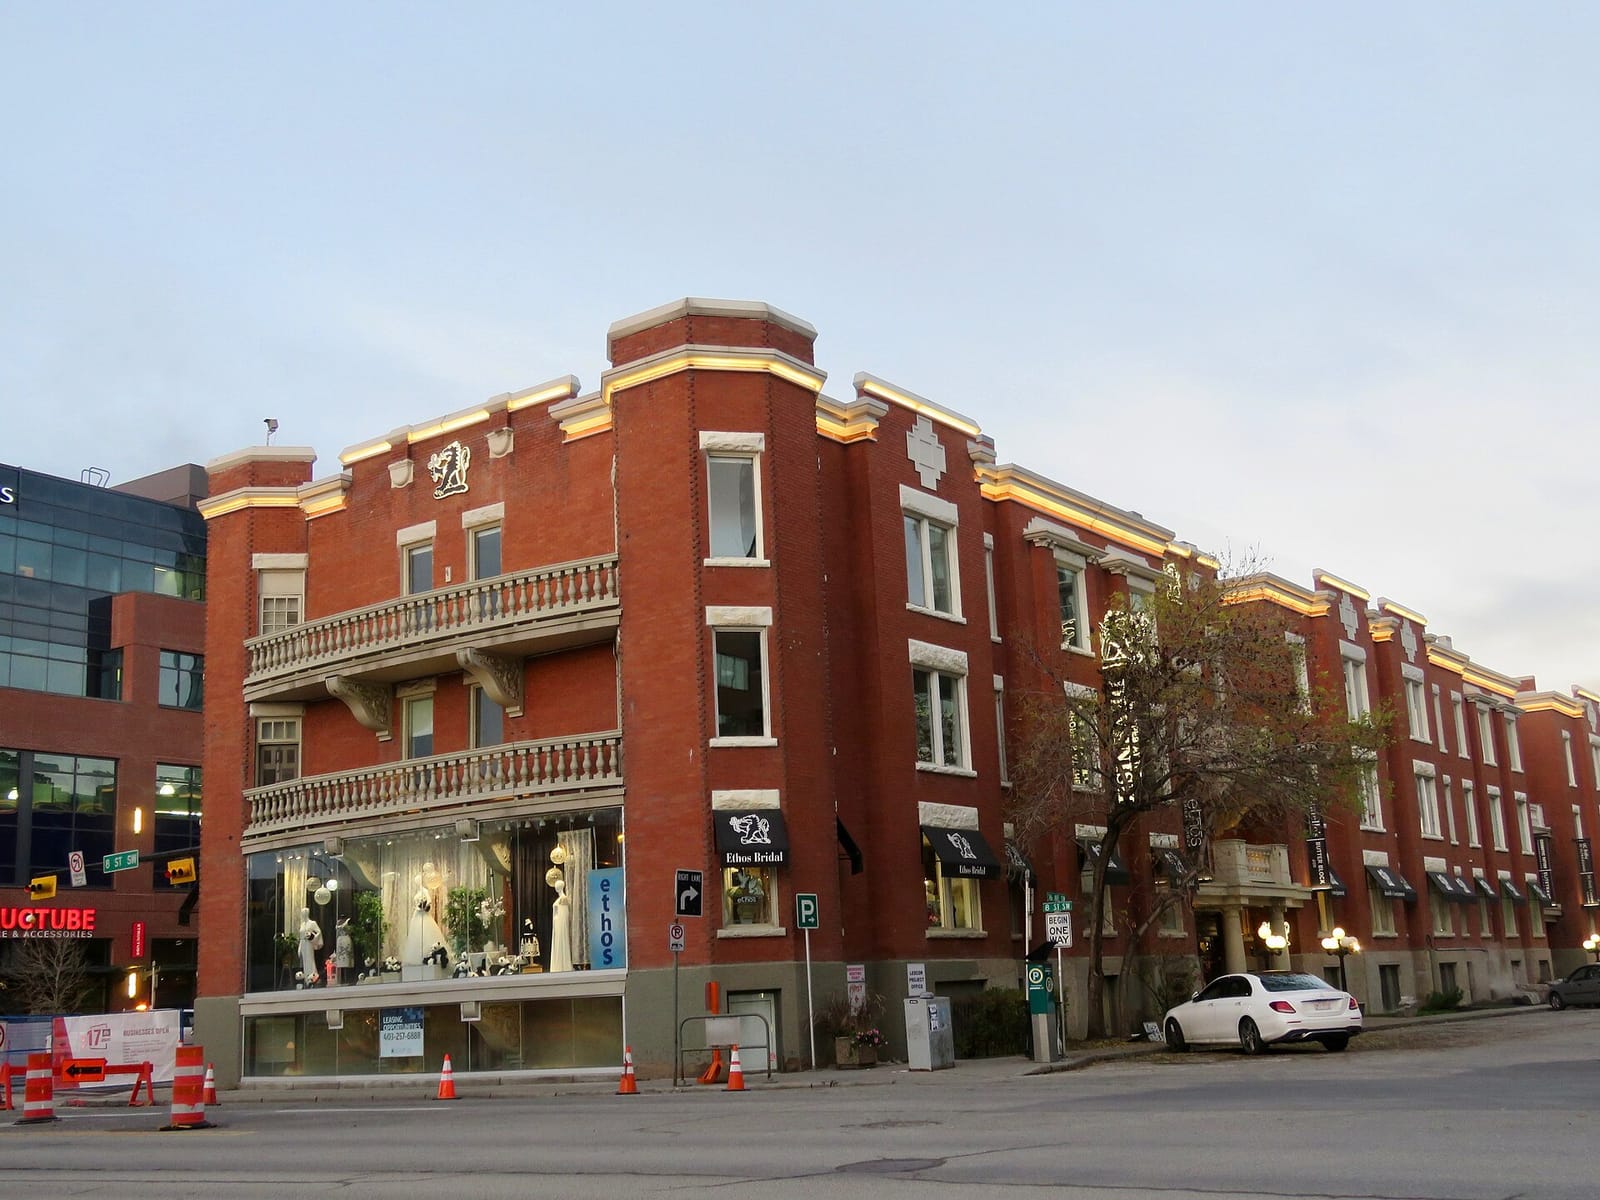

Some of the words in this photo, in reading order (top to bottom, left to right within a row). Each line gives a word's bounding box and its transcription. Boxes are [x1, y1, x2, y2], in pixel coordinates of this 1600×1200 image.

[114, 857, 123, 867] ST
[127, 854, 137, 865] SW
[726, 853, 752, 863] Ethos
[754, 851, 783, 862] Bridal
[600, 879, 613, 965] ethos
[1049, 916, 1067, 925] BEGIN
[23, 930, 93, 938] ACCESSORIES
[1050, 926, 1068, 935] ONE
[87, 1029, 102, 1046] 17
